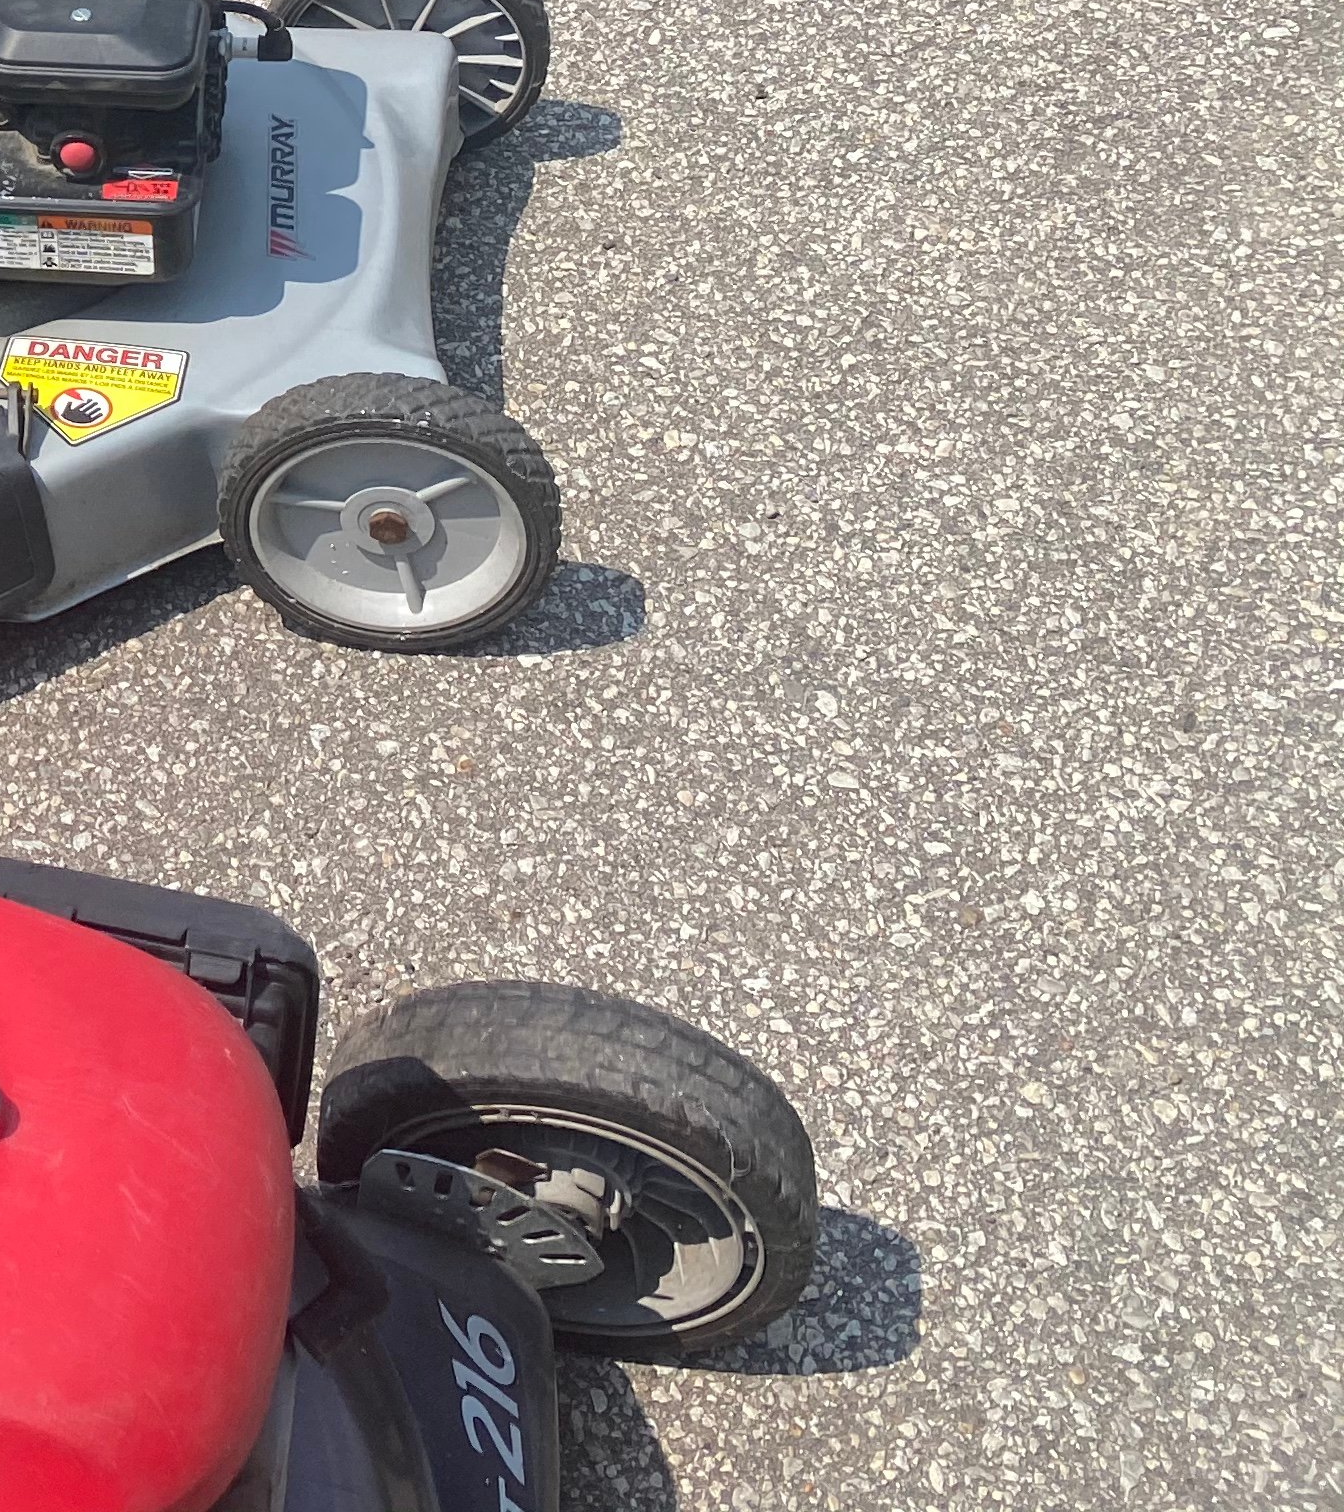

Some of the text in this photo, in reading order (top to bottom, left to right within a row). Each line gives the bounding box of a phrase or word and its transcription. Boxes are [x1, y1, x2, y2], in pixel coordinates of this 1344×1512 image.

[271, 113, 295, 231] MURRAY
[65, 218, 133, 233] WARNING
[13, 357, 172, 381] KEEP HANDS AND FEET AWAY
[27, 341, 164, 369] DANGER
[438, 1298, 526, 1486] 216
